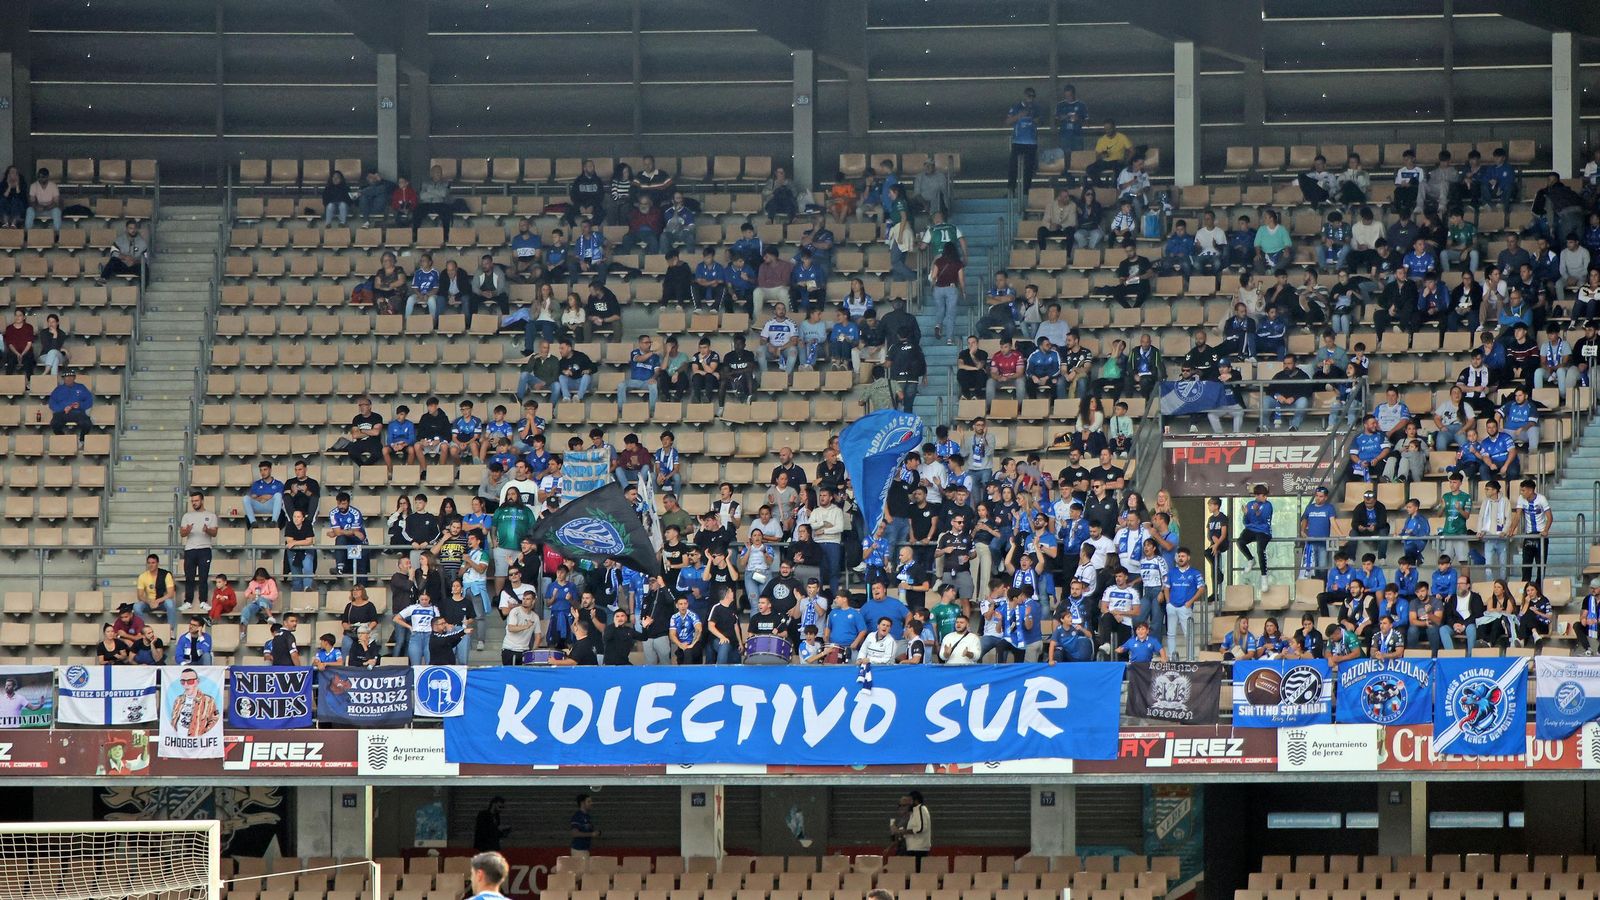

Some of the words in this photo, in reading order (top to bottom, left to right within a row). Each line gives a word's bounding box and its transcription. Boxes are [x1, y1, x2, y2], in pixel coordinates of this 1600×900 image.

[1173, 447, 1240, 464] PLAY
[1228, 445, 1321, 472] JEREZ
[1341, 658, 1382, 685] RATONES
[234, 670, 310, 694] NEW
[348, 675, 406, 690] YOUTH
[72, 690, 94, 698] XEREZ
[348, 689, 408, 704] XEREZ
[1445, 679, 1460, 717] RATONES
[1459, 668, 1495, 683] AZULAOS
[234, 694, 308, 720] ONES
[348, 703, 408, 714] HOOLIGANS
[496, 682, 897, 748] KOLECTIVO
[924, 676, 1068, 742] SUR
[1463, 732, 1488, 744] XEREZ
[1490, 702, 1517, 742] DEPORTIVO
[164, 736, 198, 748] CHOOSE
[200, 736, 218, 748] LIFE
[393, 746, 444, 754] Ayuntamient
[1312, 740, 1368, 750] Ayuntamiento
[404, 754, 425, 762] Jerez
[1146, 738, 1244, 768] JEREZ
